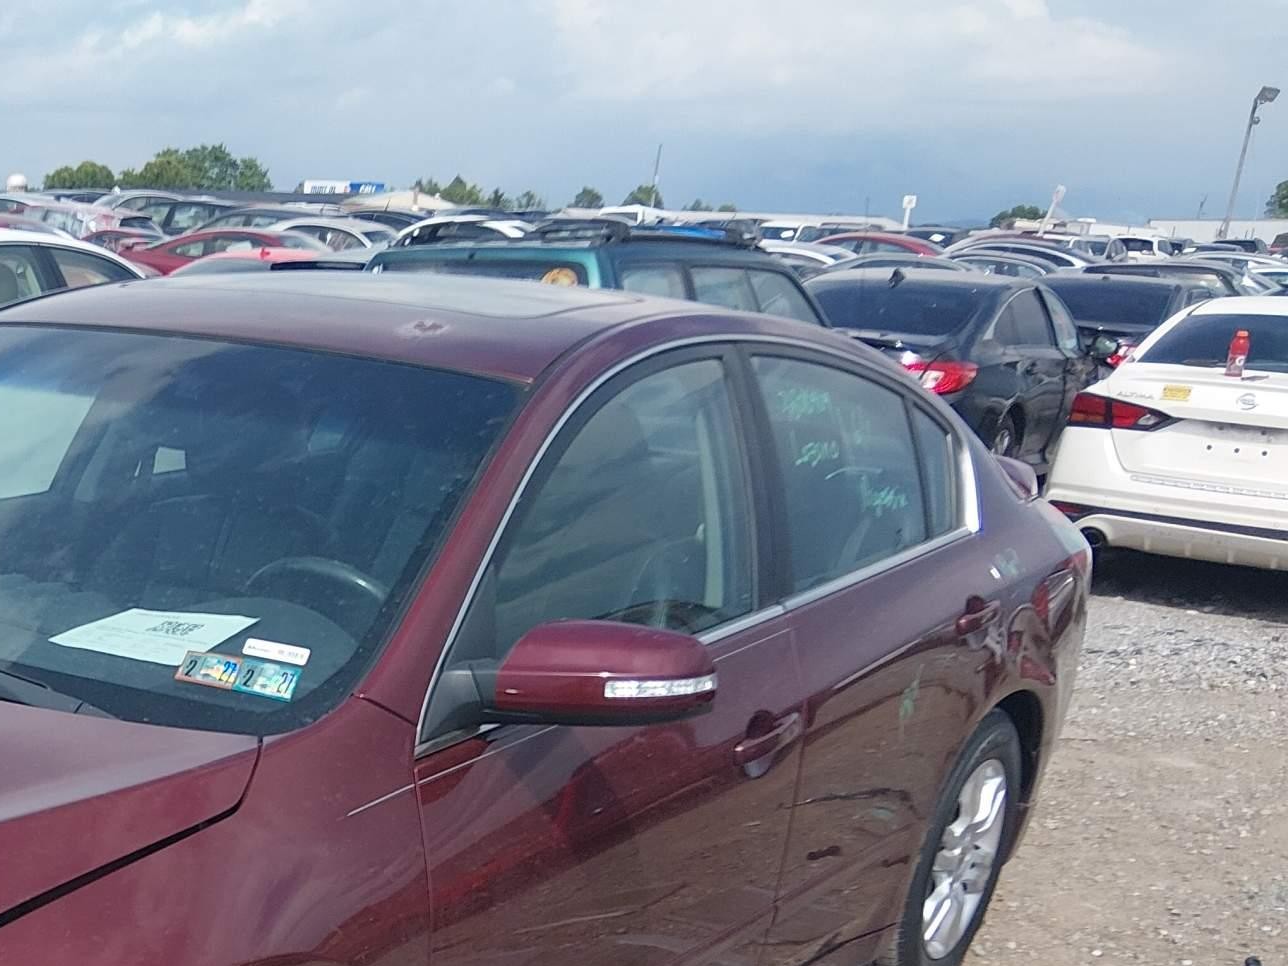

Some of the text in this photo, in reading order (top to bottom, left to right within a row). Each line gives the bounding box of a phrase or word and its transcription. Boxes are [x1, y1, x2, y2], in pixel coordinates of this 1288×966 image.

[184, 659, 238, 684] 2 27
[242, 668, 295, 694] 2 27
